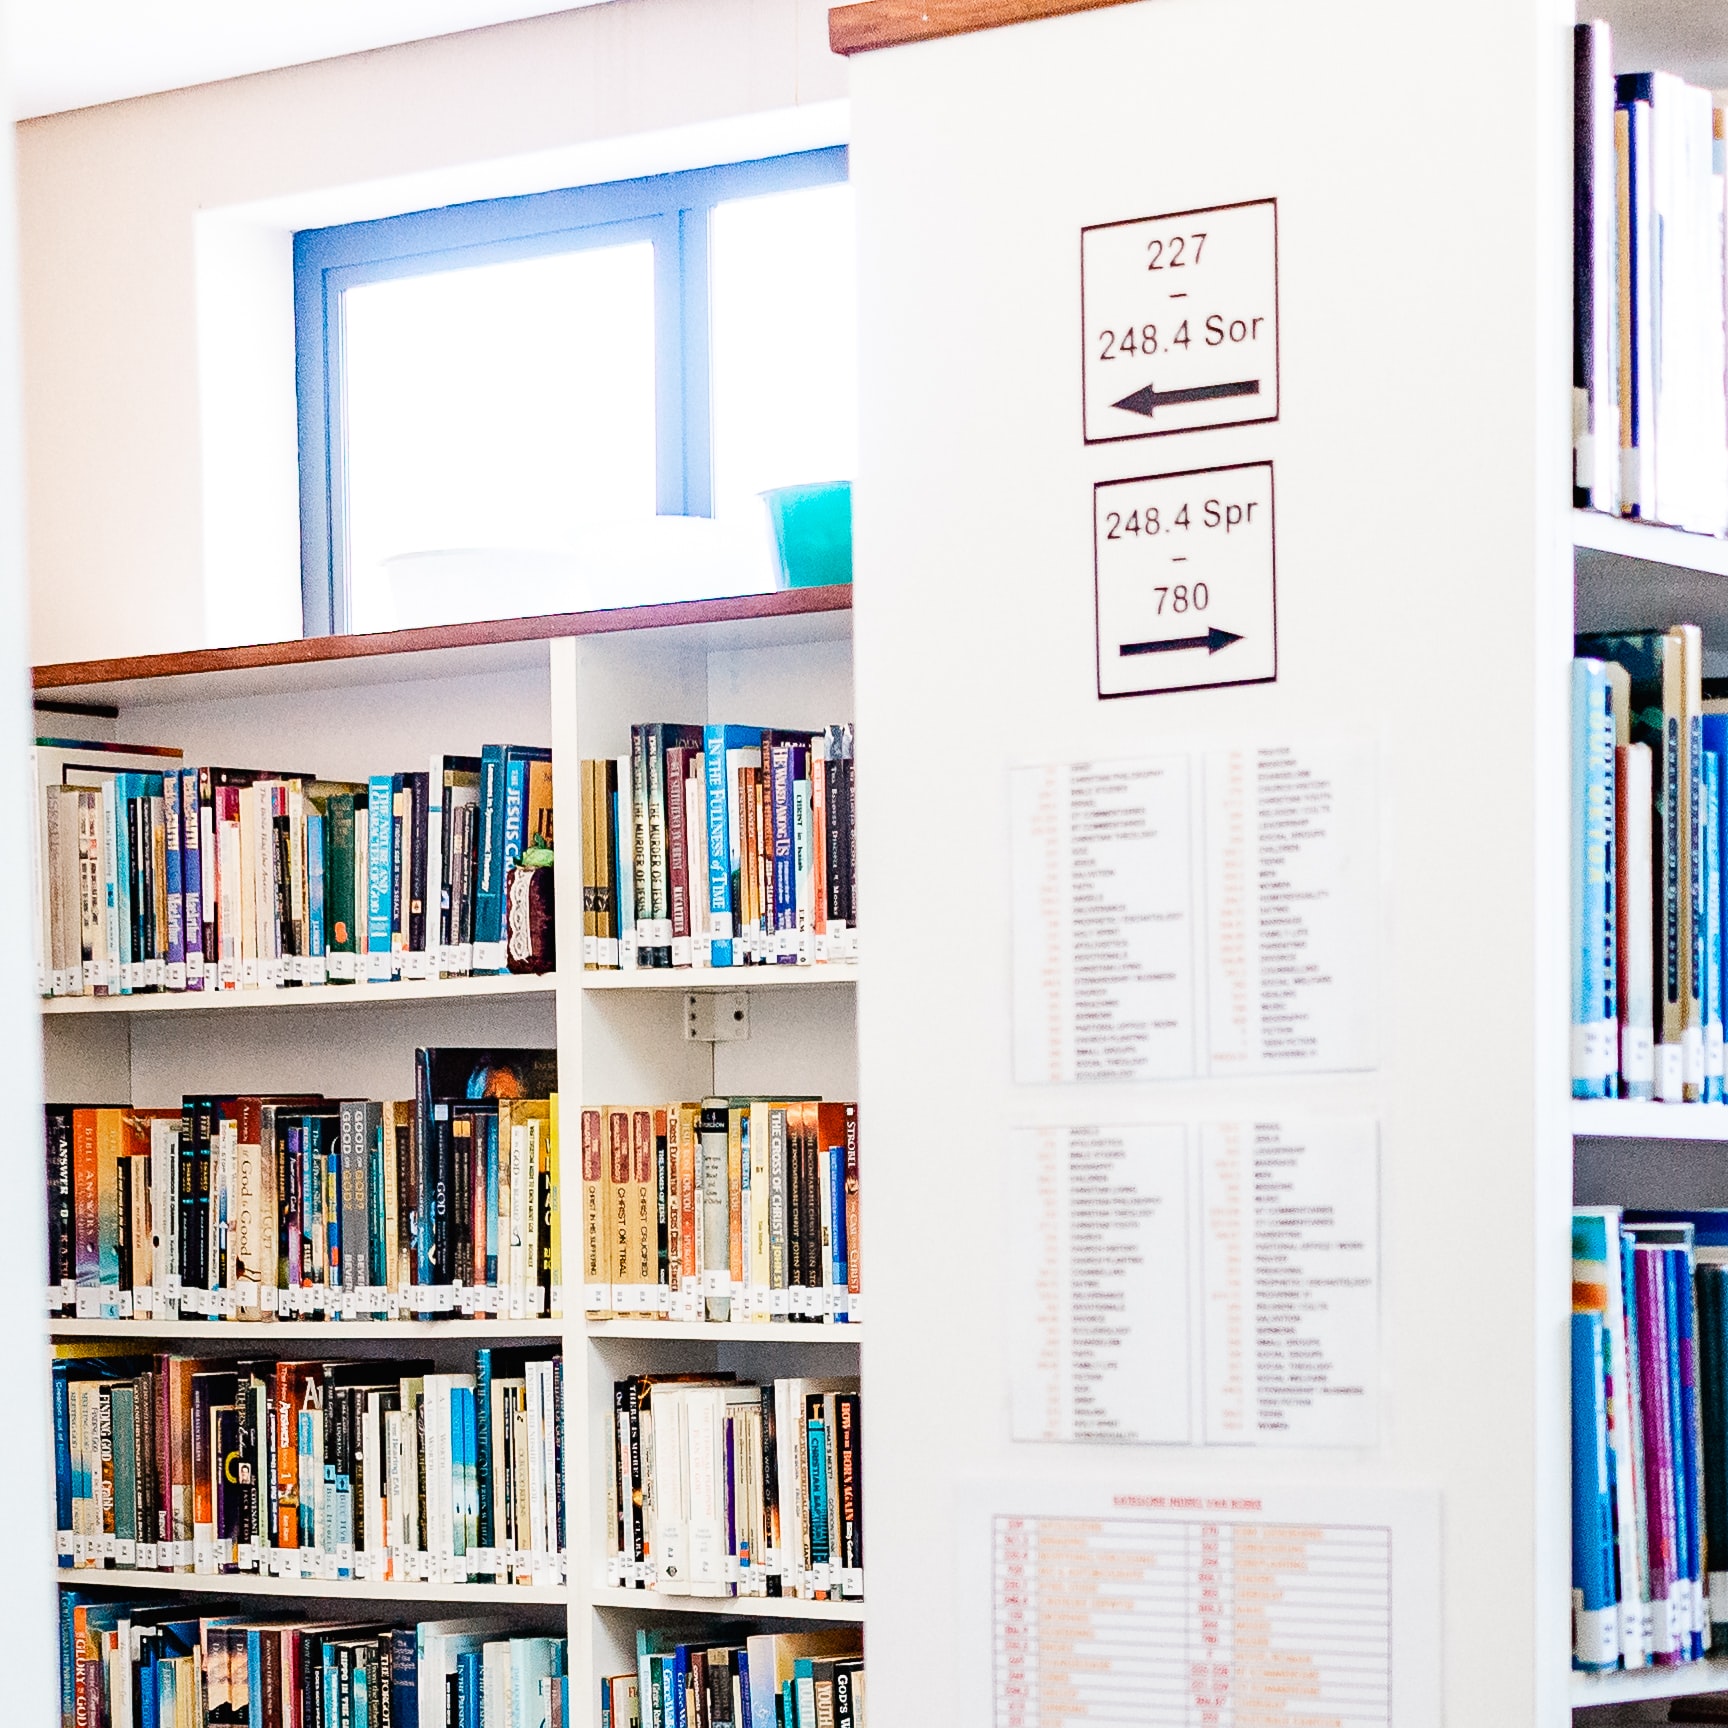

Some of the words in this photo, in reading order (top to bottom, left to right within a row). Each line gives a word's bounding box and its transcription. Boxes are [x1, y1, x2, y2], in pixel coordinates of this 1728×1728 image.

[1147, 233, 1207, 271] 227
[1098, 318, 1192, 361] 248.4
[1204, 314, 1264, 347] Sor
[1106, 502, 1190, 540] 248.4
[1204, 499, 1259, 534] Spr
[1153, 582, 1209, 614] 780
[708, 738, 722, 754] IN
[772, 749, 788, 764] HE
[708, 759, 722, 785] THE
[506, 789, 519, 839] JESUS
[650, 803, 659, 819] THE
[710, 789, 725, 856] FULLNESS
[650, 824, 660, 868] MURDER
[776, 838, 790, 856] US
[651, 871, 661, 885] OF
[710, 860, 722, 871] of
[652, 888, 662, 913] JESUS
[712, 875, 726, 909] TIME
[342, 1111, 351, 1154] GOOD
[354, 1111, 364, 1154] GOOD
[772, 1113, 781, 1137] THE
[772, 1140, 781, 1174] CROSS
[847, 1122, 855, 1168] STROBEL
[60, 1140, 68, 1195] ANSWER
[241, 1161, 251, 1196] God
[773, 1177, 782, 1192] OF
[343, 1170, 352, 1210] GOD?
[355, 1170, 364, 1210] GOD?
[437, 1182, 446, 1216] GOD
[617, 1188, 626, 1225] CHRIST
[639, 1187, 648, 1222] CHRIST
[773, 1195, 783, 1235] CHRIST
[241, 1210, 251, 1256] Good
[618, 1229, 627, 1244] ON
[619, 1250, 627, 1277] TRIAL
[640, 1227, 649, 1277] CRUCIFIED
[773, 1246, 782, 1273] JOHN
[850, 1251, 858, 1290] CHRIST
[99, 1394, 111, 1436] FINDING
[629, 1385, 637, 1422] THERE
[841, 1402, 851, 1429] HOW
[280, 1401, 291, 1448] Answers
[630, 1426, 638, 1437] IS
[101, 1439, 112, 1462] GOD
[479, 1453, 488, 1477] GOD
[811, 1438, 821, 1493] CHRISTIAN
[842, 1450, 853, 1482] BORN
[102, 1480, 113, 1510] Crabb
[843, 1484, 854, 1520] AGAIN
[634, 1520, 642, 1557] CLARK
[76, 1640, 87, 1683] GLORY
[381, 1654, 389, 1678] THE
[341, 1683, 349, 1693] IN
[817, 1685, 832, 1726] YOUTH
[838, 1675, 847, 1713] GOD'S
[77, 1696, 87, 1726] GOD
